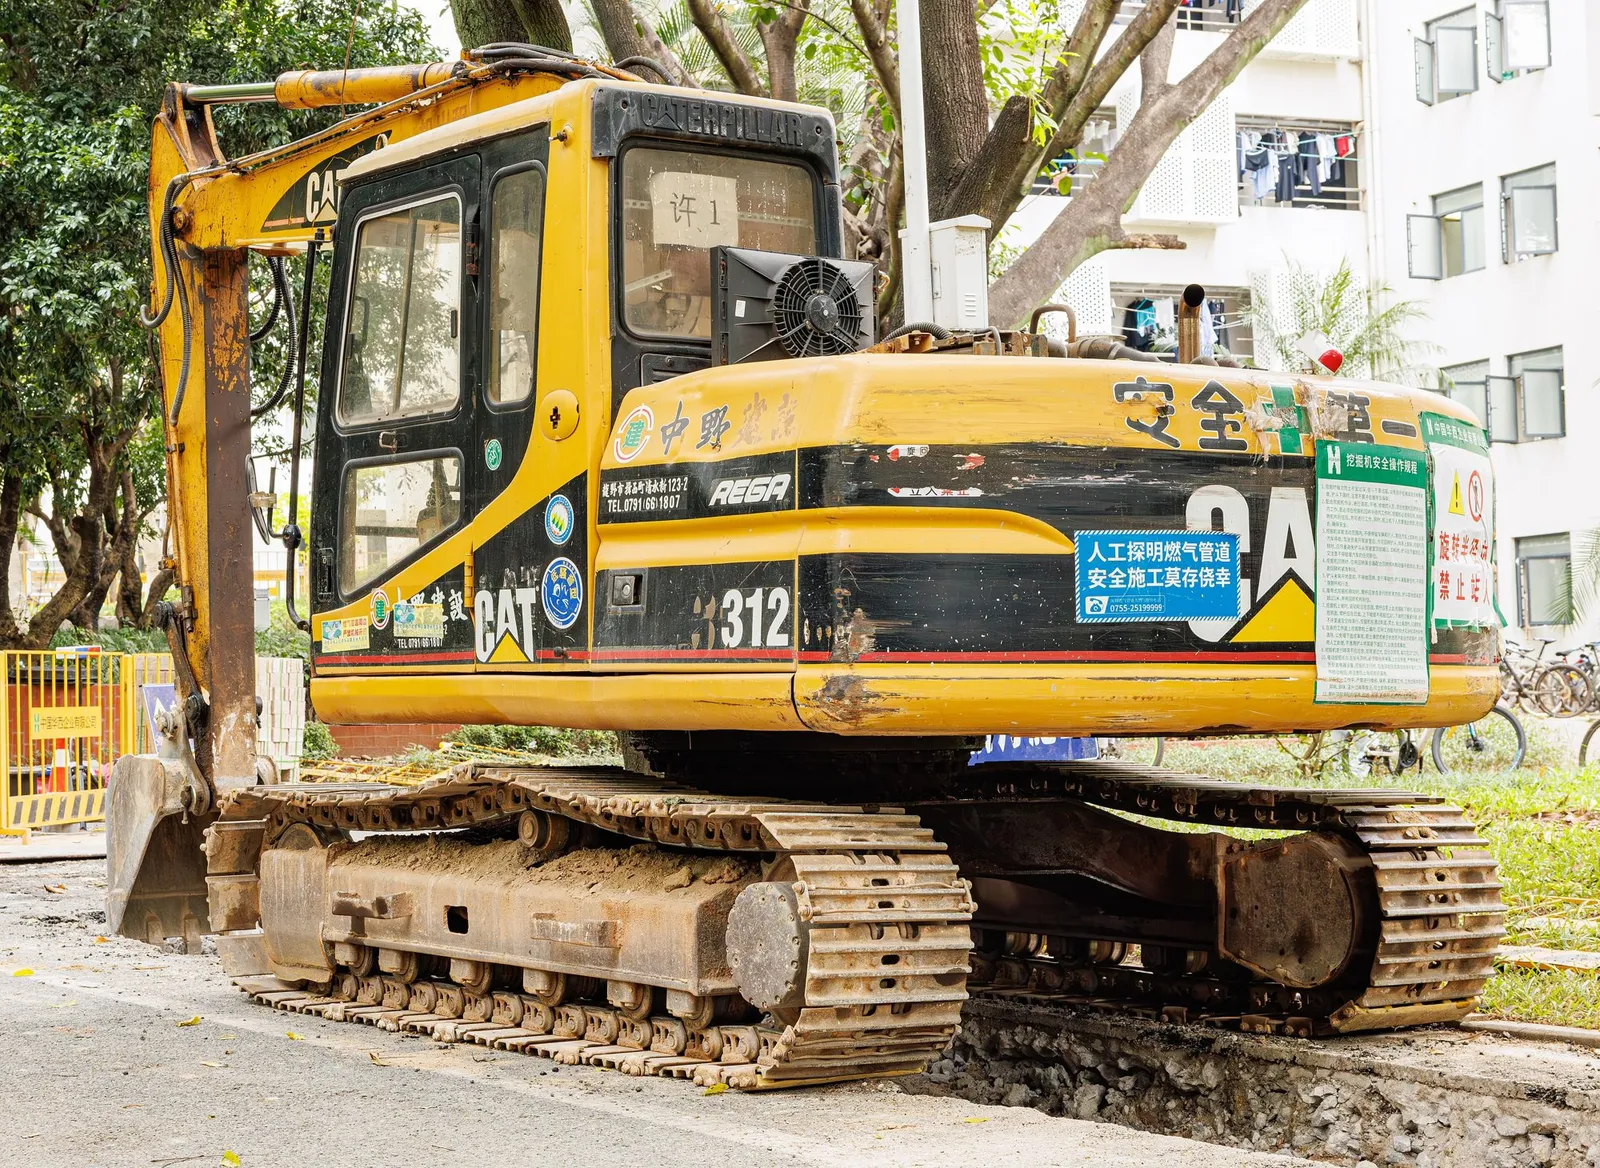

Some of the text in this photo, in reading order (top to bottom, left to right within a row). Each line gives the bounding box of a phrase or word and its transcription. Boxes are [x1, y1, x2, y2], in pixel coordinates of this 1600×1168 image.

[641, 94, 804, 147] CATERPILLAR
[1346, 453, 1419, 475] 挖掘机安全操作规程
[1087, 541, 1231, 563] 人工探明燃气管道
[1087, 566, 1231, 590] 安全施工莫存侥幸
[721, 587, 790, 648] 312
[1110, 603, 1163, 613] 0755-25199999
[474, 588, 536, 663] CAT
